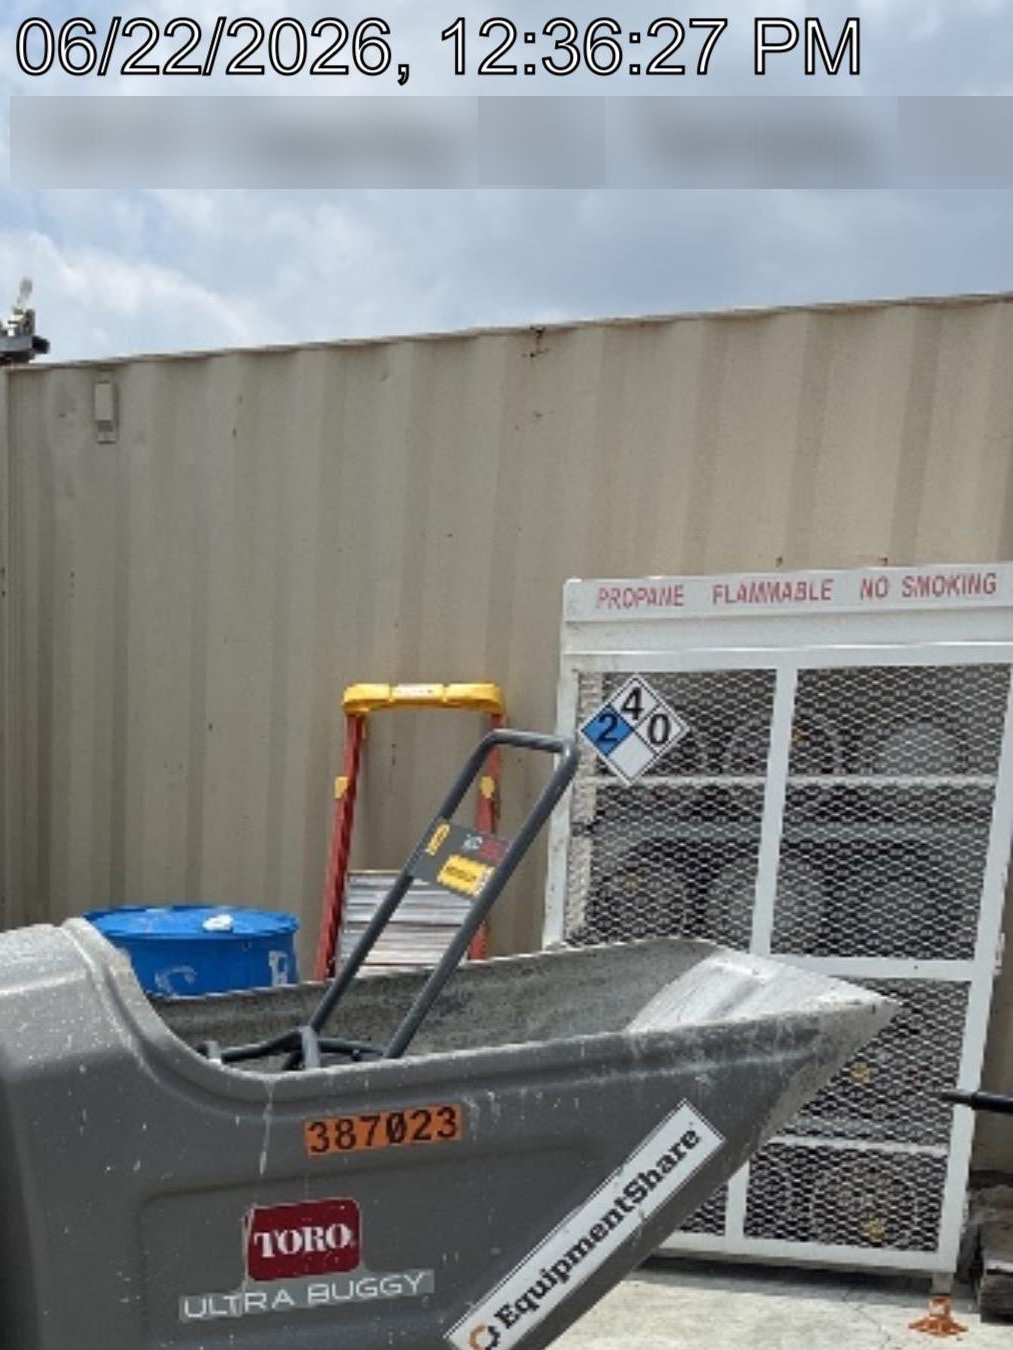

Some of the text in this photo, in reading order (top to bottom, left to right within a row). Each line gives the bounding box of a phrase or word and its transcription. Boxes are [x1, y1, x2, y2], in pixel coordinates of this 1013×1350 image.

[596, 572, 997, 610] PROPANE FLAMMABLE NO SMOKING
[621, 686, 644, 720] 4
[596, 713, 619, 742] 2
[648, 713, 670, 744] 0
[308, 1106, 457, 1153] 387023
[253, 1223, 352, 1258] TORO
[494, 1128, 701, 1330] EquipmentShare
[184, 1272, 426, 1319] ULTRA BUGGY
